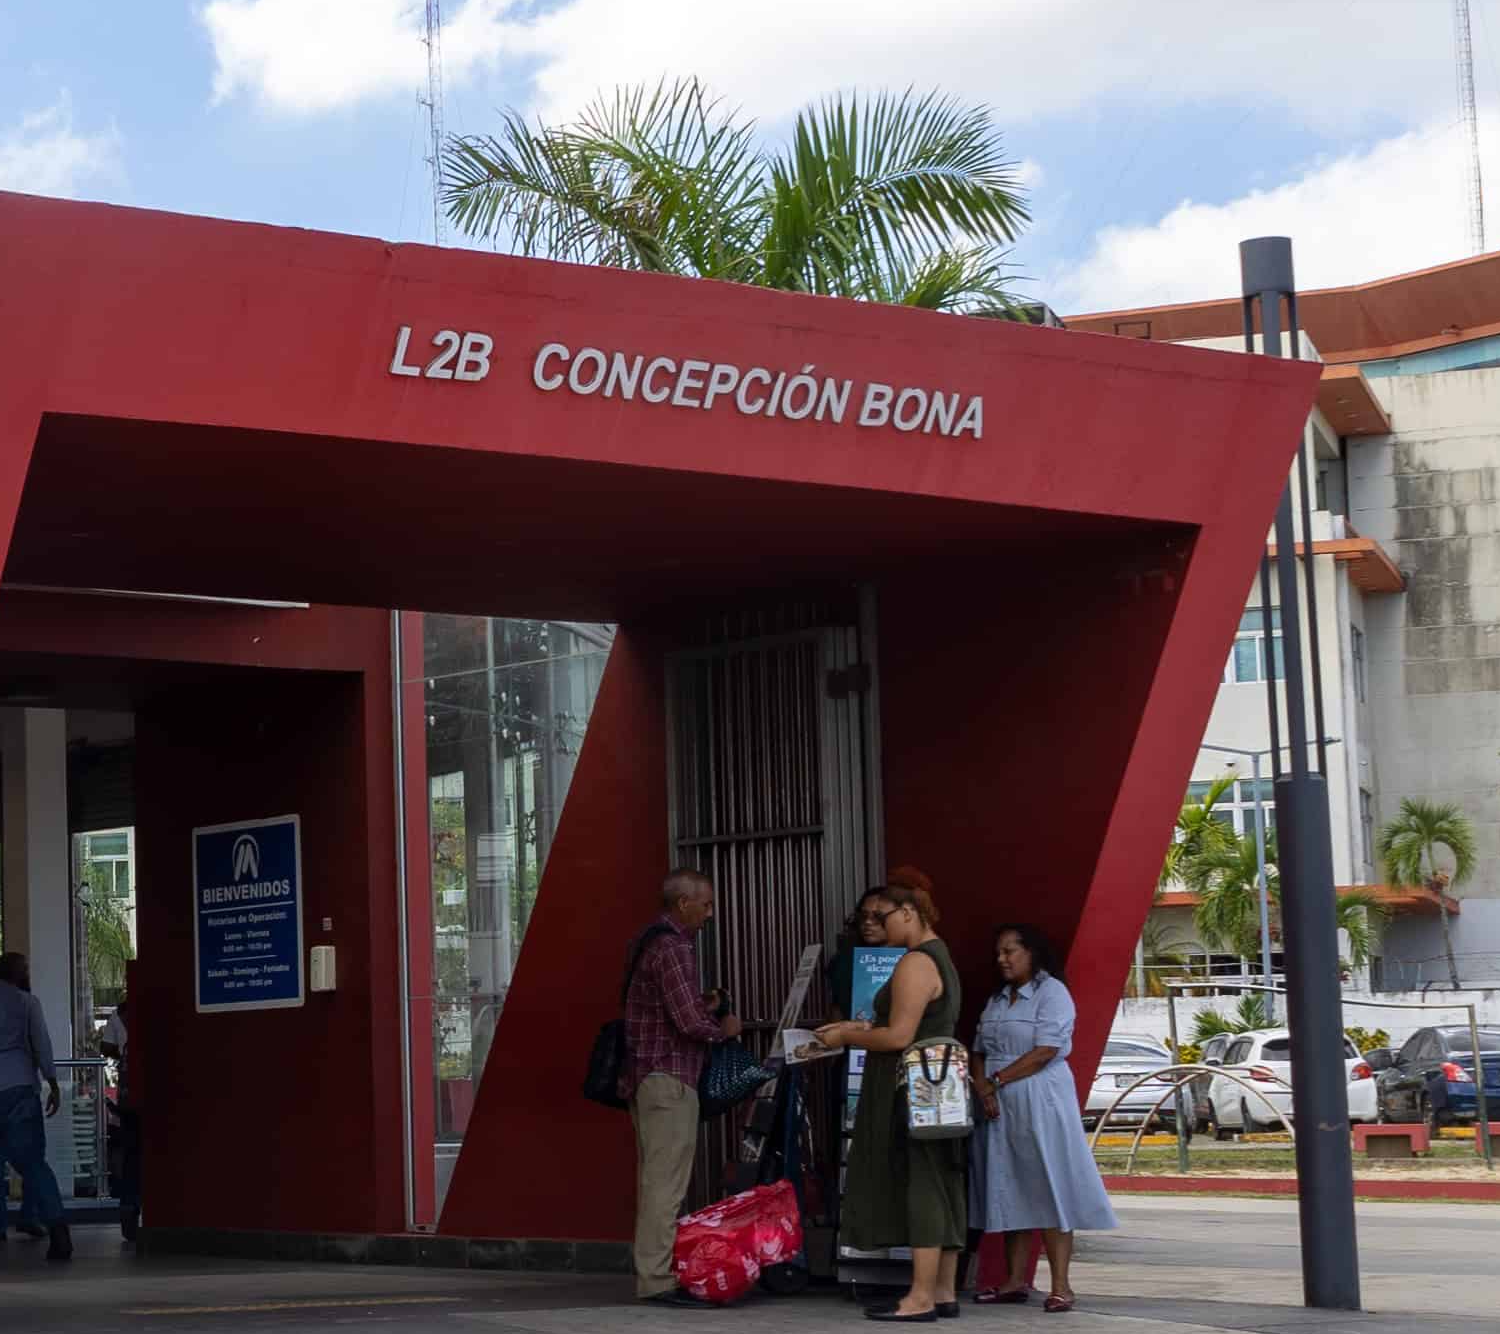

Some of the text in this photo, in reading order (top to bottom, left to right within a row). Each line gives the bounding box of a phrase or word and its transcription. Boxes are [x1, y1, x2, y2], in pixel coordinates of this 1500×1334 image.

[389, 326, 984, 439] L2B CONCEPCIÓN BONA
[203, 879, 290, 904] BIENVENIDOS
